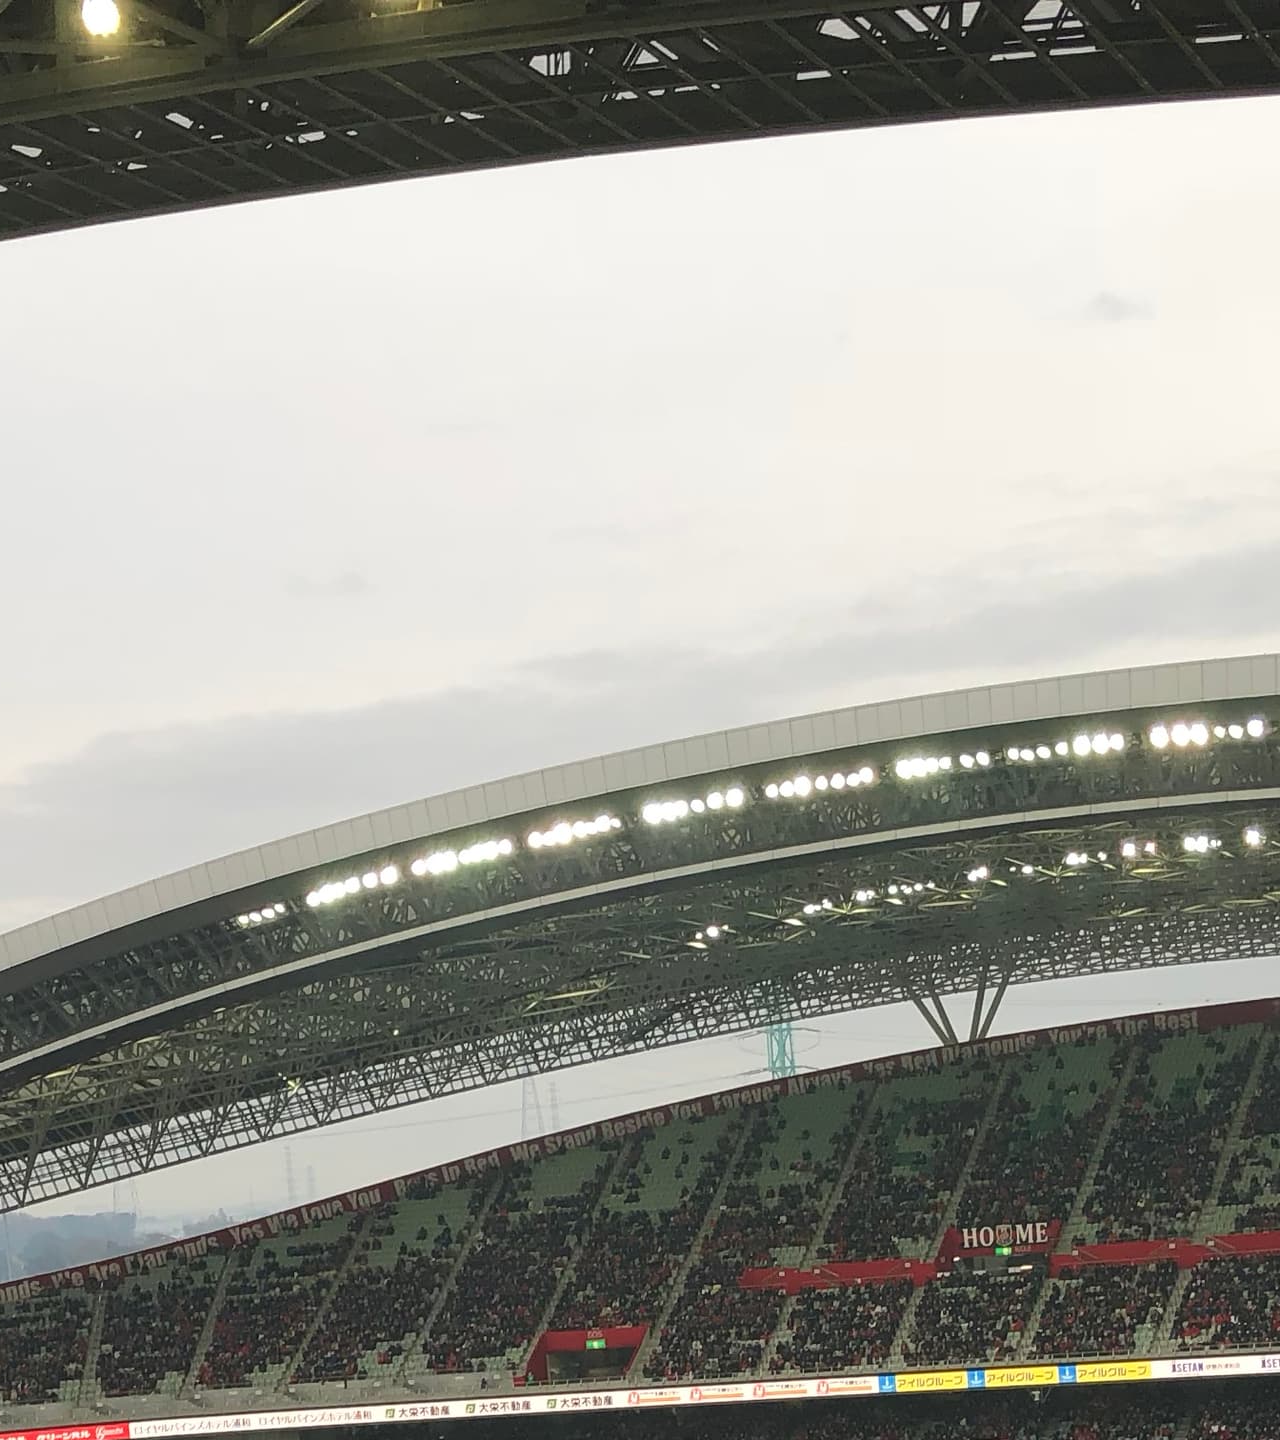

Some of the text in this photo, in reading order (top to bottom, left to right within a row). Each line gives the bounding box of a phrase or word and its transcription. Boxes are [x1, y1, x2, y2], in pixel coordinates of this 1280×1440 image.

[1048, 1020, 1107, 1045] You're
[1154, 1010, 1199, 1032] Best
[712, 1085, 782, 1113] Forever
[510, 1103, 703, 1163] We Stand Beside You
[464, 1153, 500, 1178] Red
[229, 1190, 381, 1246] Yes We Love You
[52, 1269, 83, 1290] We
[92, 1260, 121, 1282] Are
[897, 1375, 963, 1387] アイルグループ
[987, 1371, 1054, 1384] アイルグループ
[1078, 1366, 1147, 1379] アイルグループ
[398, 1405, 451, 1418] 大栄不動産
[479, 1400, 531, 1413] 大栄不動産
[560, 1397, 614, 1408] 大栄不動産
